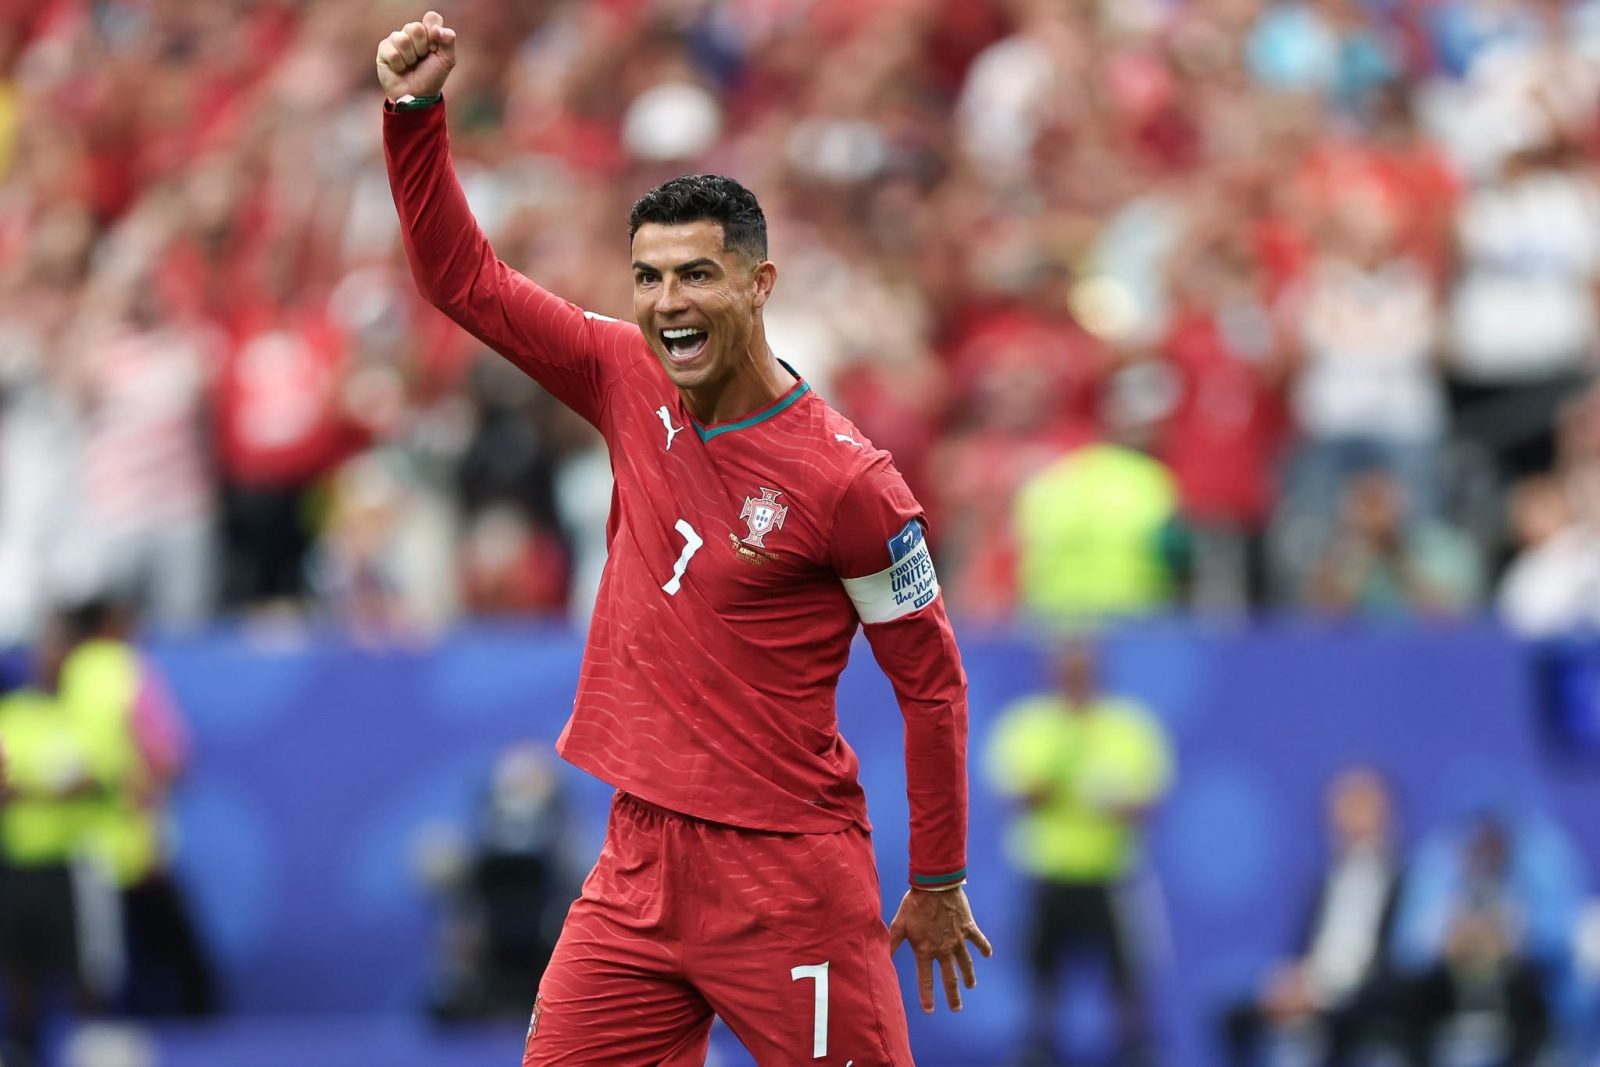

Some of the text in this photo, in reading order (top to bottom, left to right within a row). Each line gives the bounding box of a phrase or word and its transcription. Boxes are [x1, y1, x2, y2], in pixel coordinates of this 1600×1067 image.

[661, 518, 704, 596] 7
[889, 547, 927, 579] FOOTBALL
[891, 555, 931, 592] UNITES
[892, 591, 914, 605] the
[915, 590, 934, 608] FIFA
